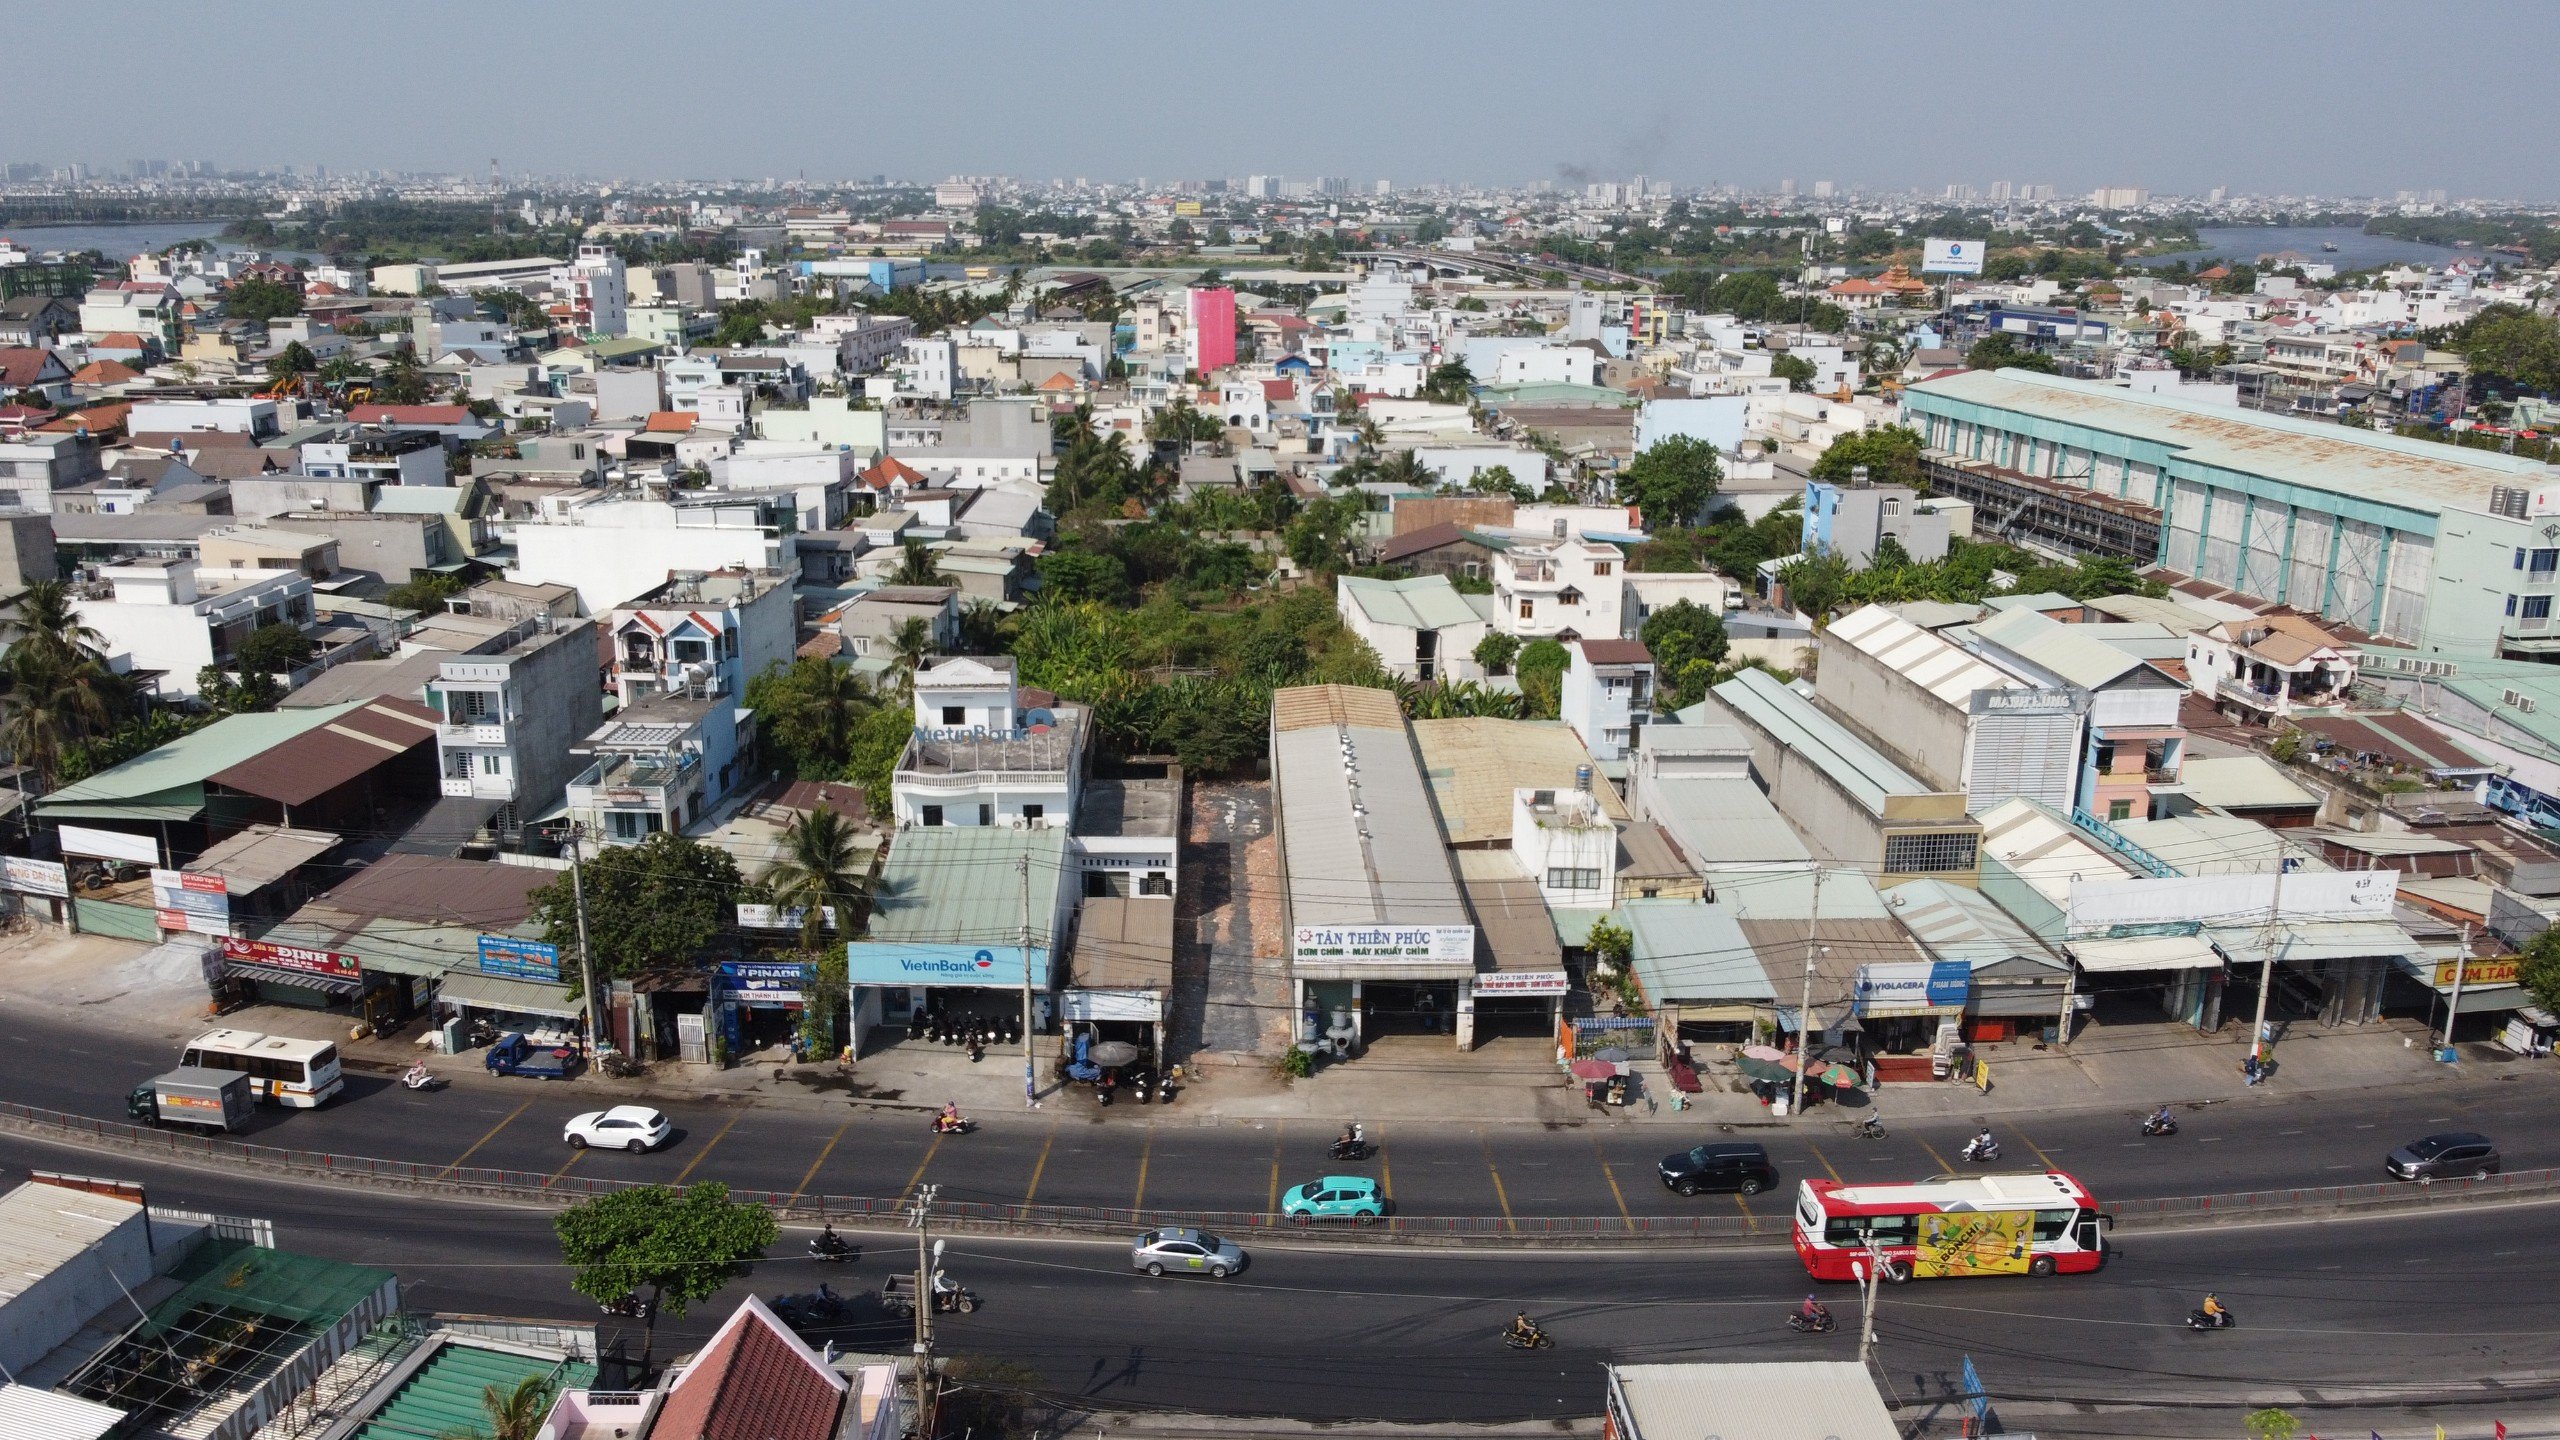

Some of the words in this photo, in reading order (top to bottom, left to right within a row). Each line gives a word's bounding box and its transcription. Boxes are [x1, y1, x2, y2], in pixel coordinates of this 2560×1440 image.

[913, 725, 1030, 744] VietinBank
[1315, 930, 1343, 945] TÂN
[1347, 929, 1393, 945] THIÊN
[1395, 928, 1431, 945] PHÚC
[1352, 946, 1372, 956] MÁY
[1374, 945, 1403, 956] KHUẤY
[901, 959, 976, 972] VietinBank
[262, 1334, 333, 1424] MINH
